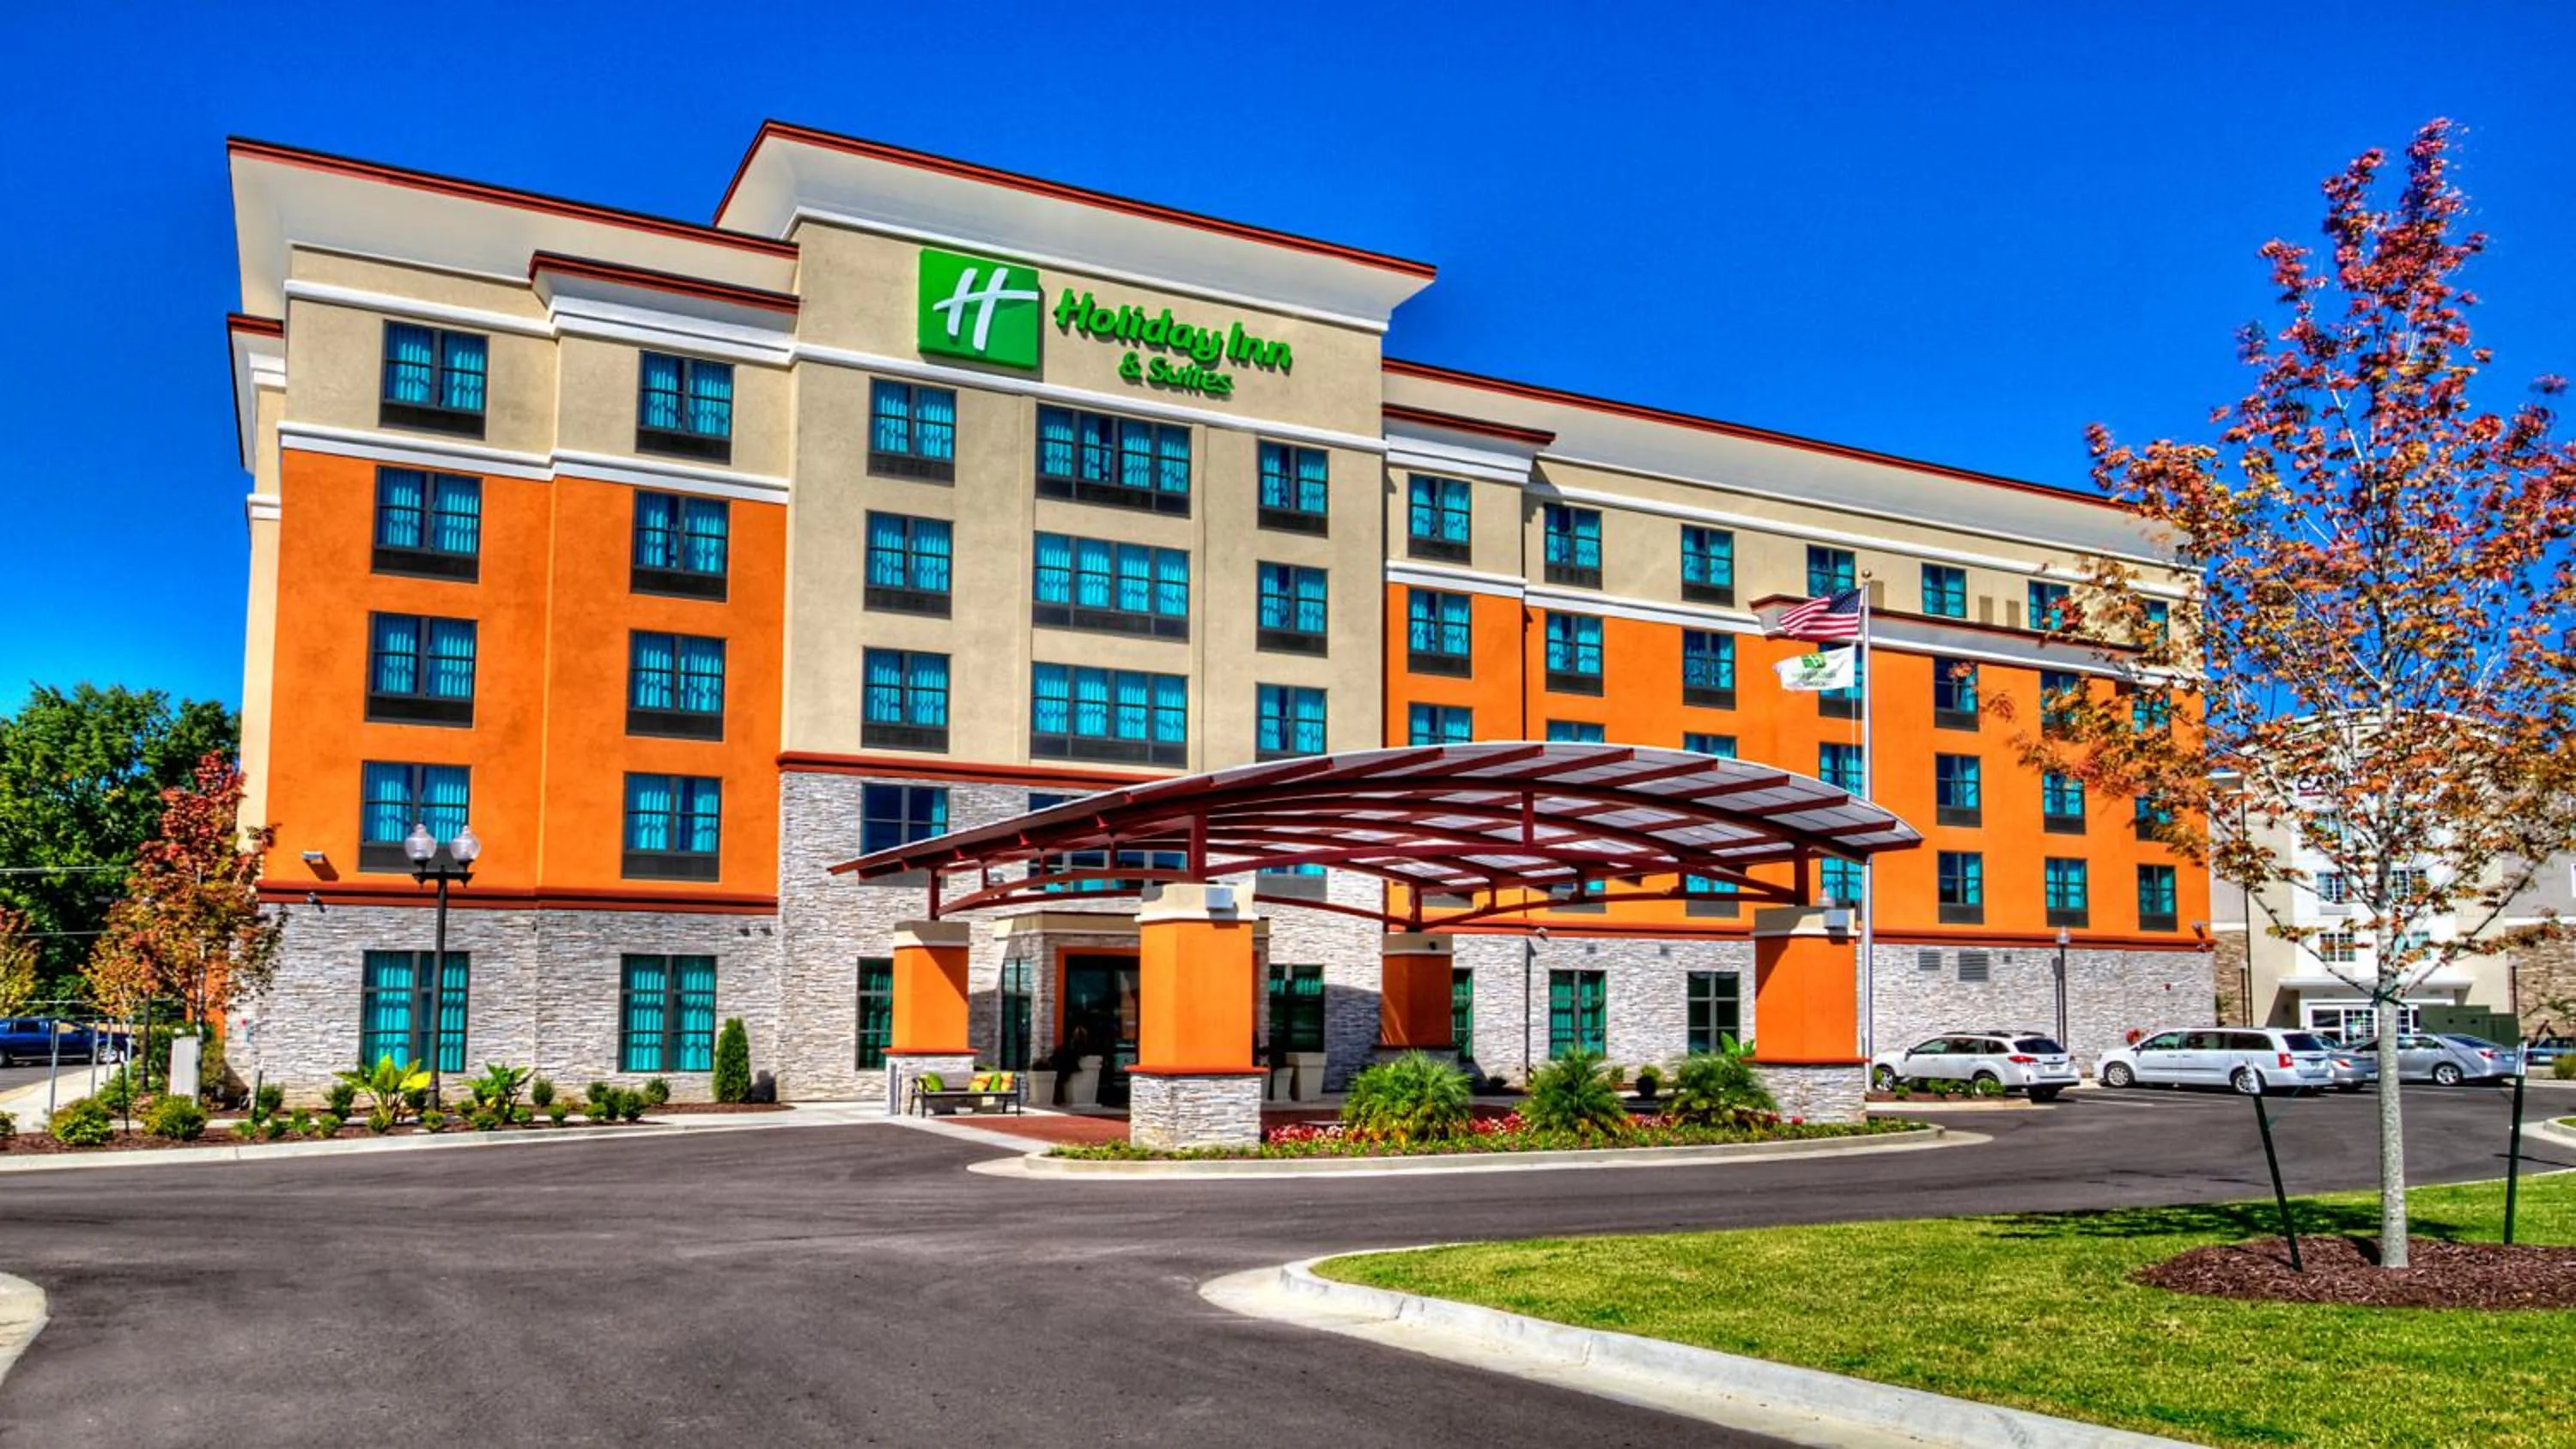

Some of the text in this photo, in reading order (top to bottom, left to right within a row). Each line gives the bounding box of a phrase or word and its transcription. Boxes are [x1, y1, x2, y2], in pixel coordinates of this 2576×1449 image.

[933, 267, 1039, 350] H
[1054, 288, 1292, 369] Holiday Inn
[1118, 350, 1233, 394] & Suites
